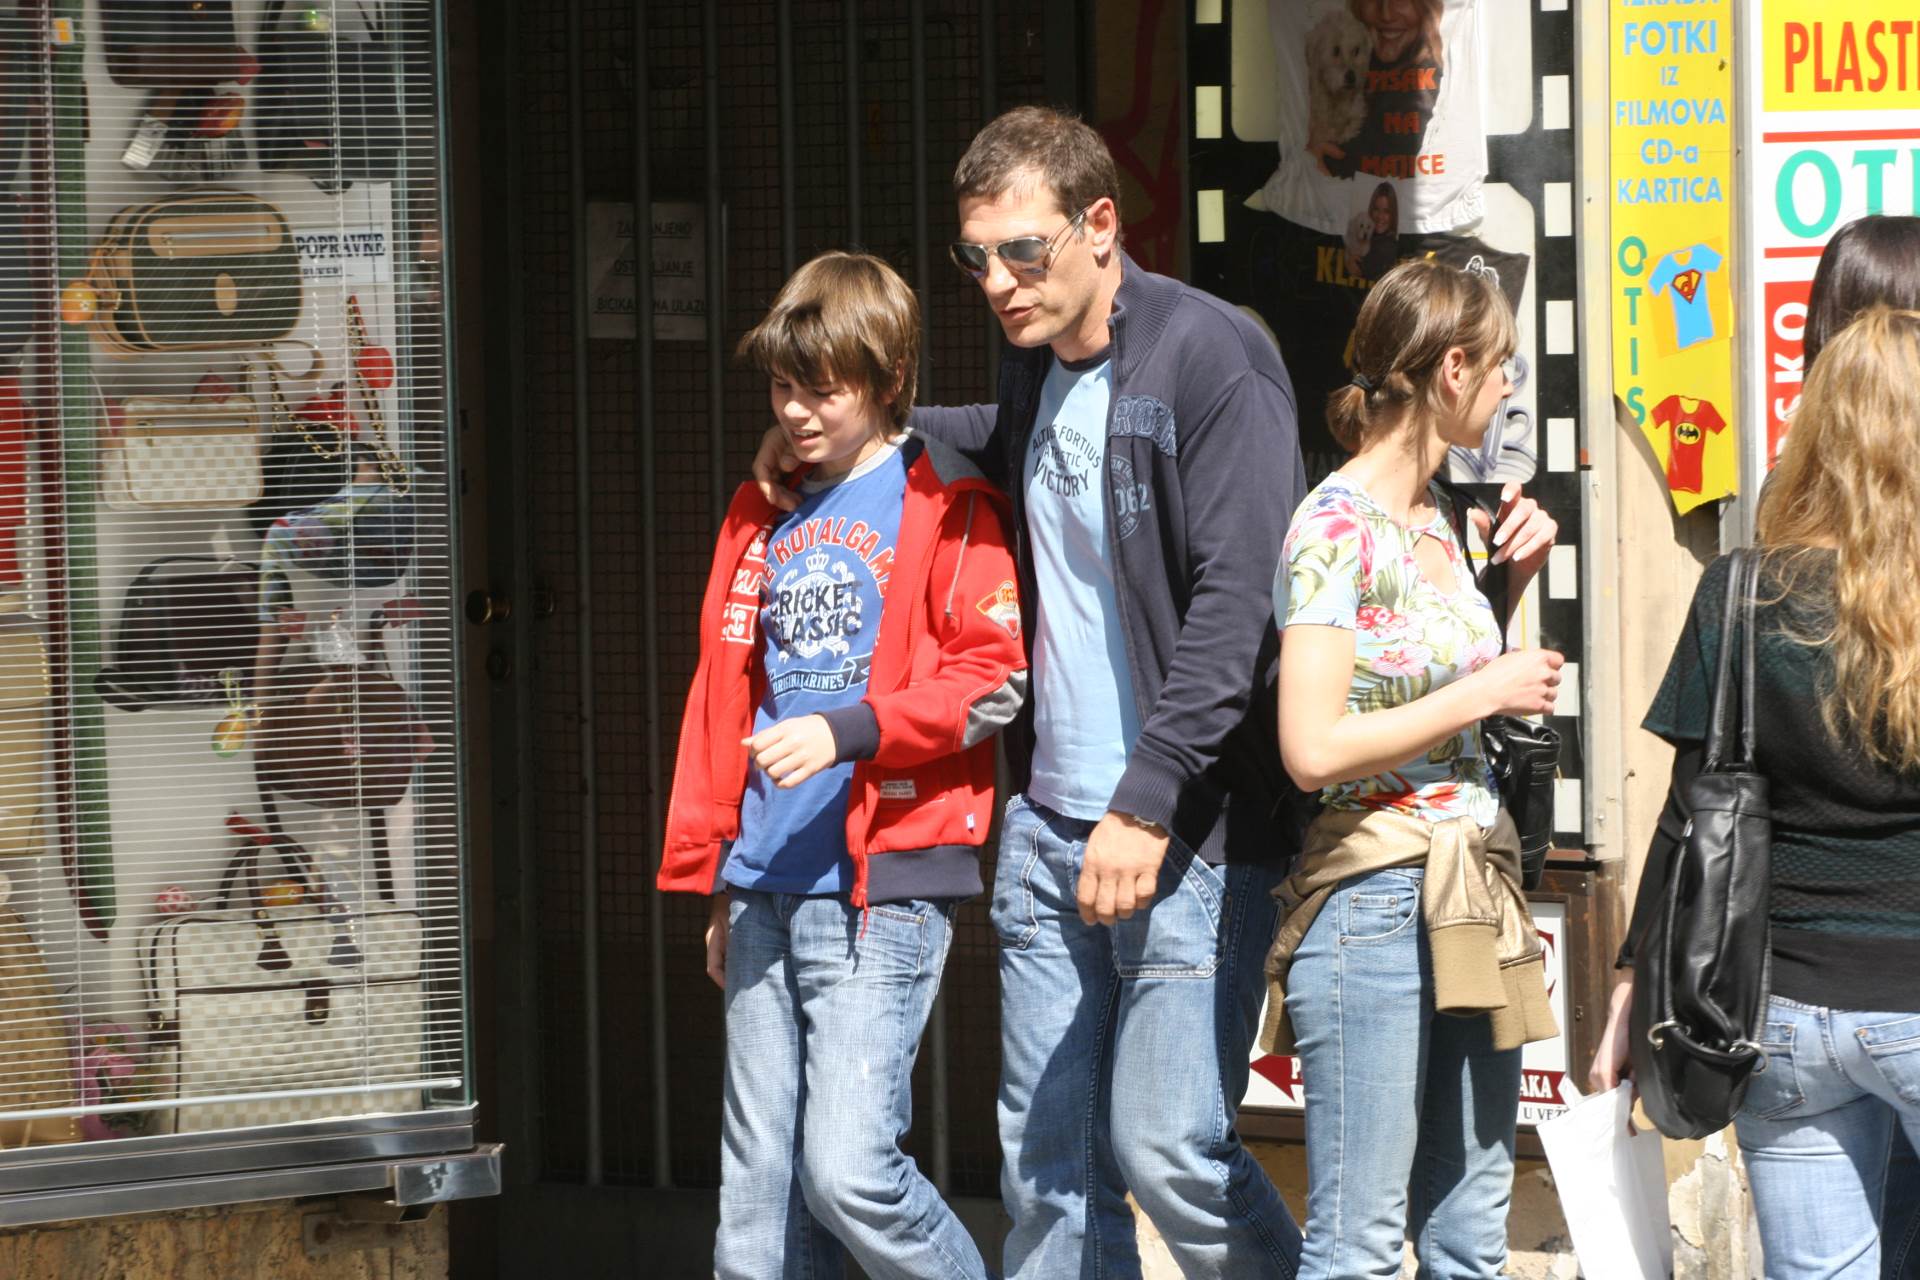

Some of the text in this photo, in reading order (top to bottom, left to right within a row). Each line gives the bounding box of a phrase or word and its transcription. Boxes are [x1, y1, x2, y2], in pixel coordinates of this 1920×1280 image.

[1624, 20, 1717, 55] FOTKI
[1661, 66, 1680, 86] IZ
[1616, 98, 1726, 126] FILMOVA
[1640, 139, 1699, 164] CD-a
[1617, 177, 1723, 203] KARTICA
[1618, 236, 1647, 426] OTIS
[1058, 425, 1102, 469] FORTIUS
[1033, 455, 1090, 498] VICTORY
[770, 580, 863, 617] CRICKET
[1523, 1107, 1533, 1120] U
